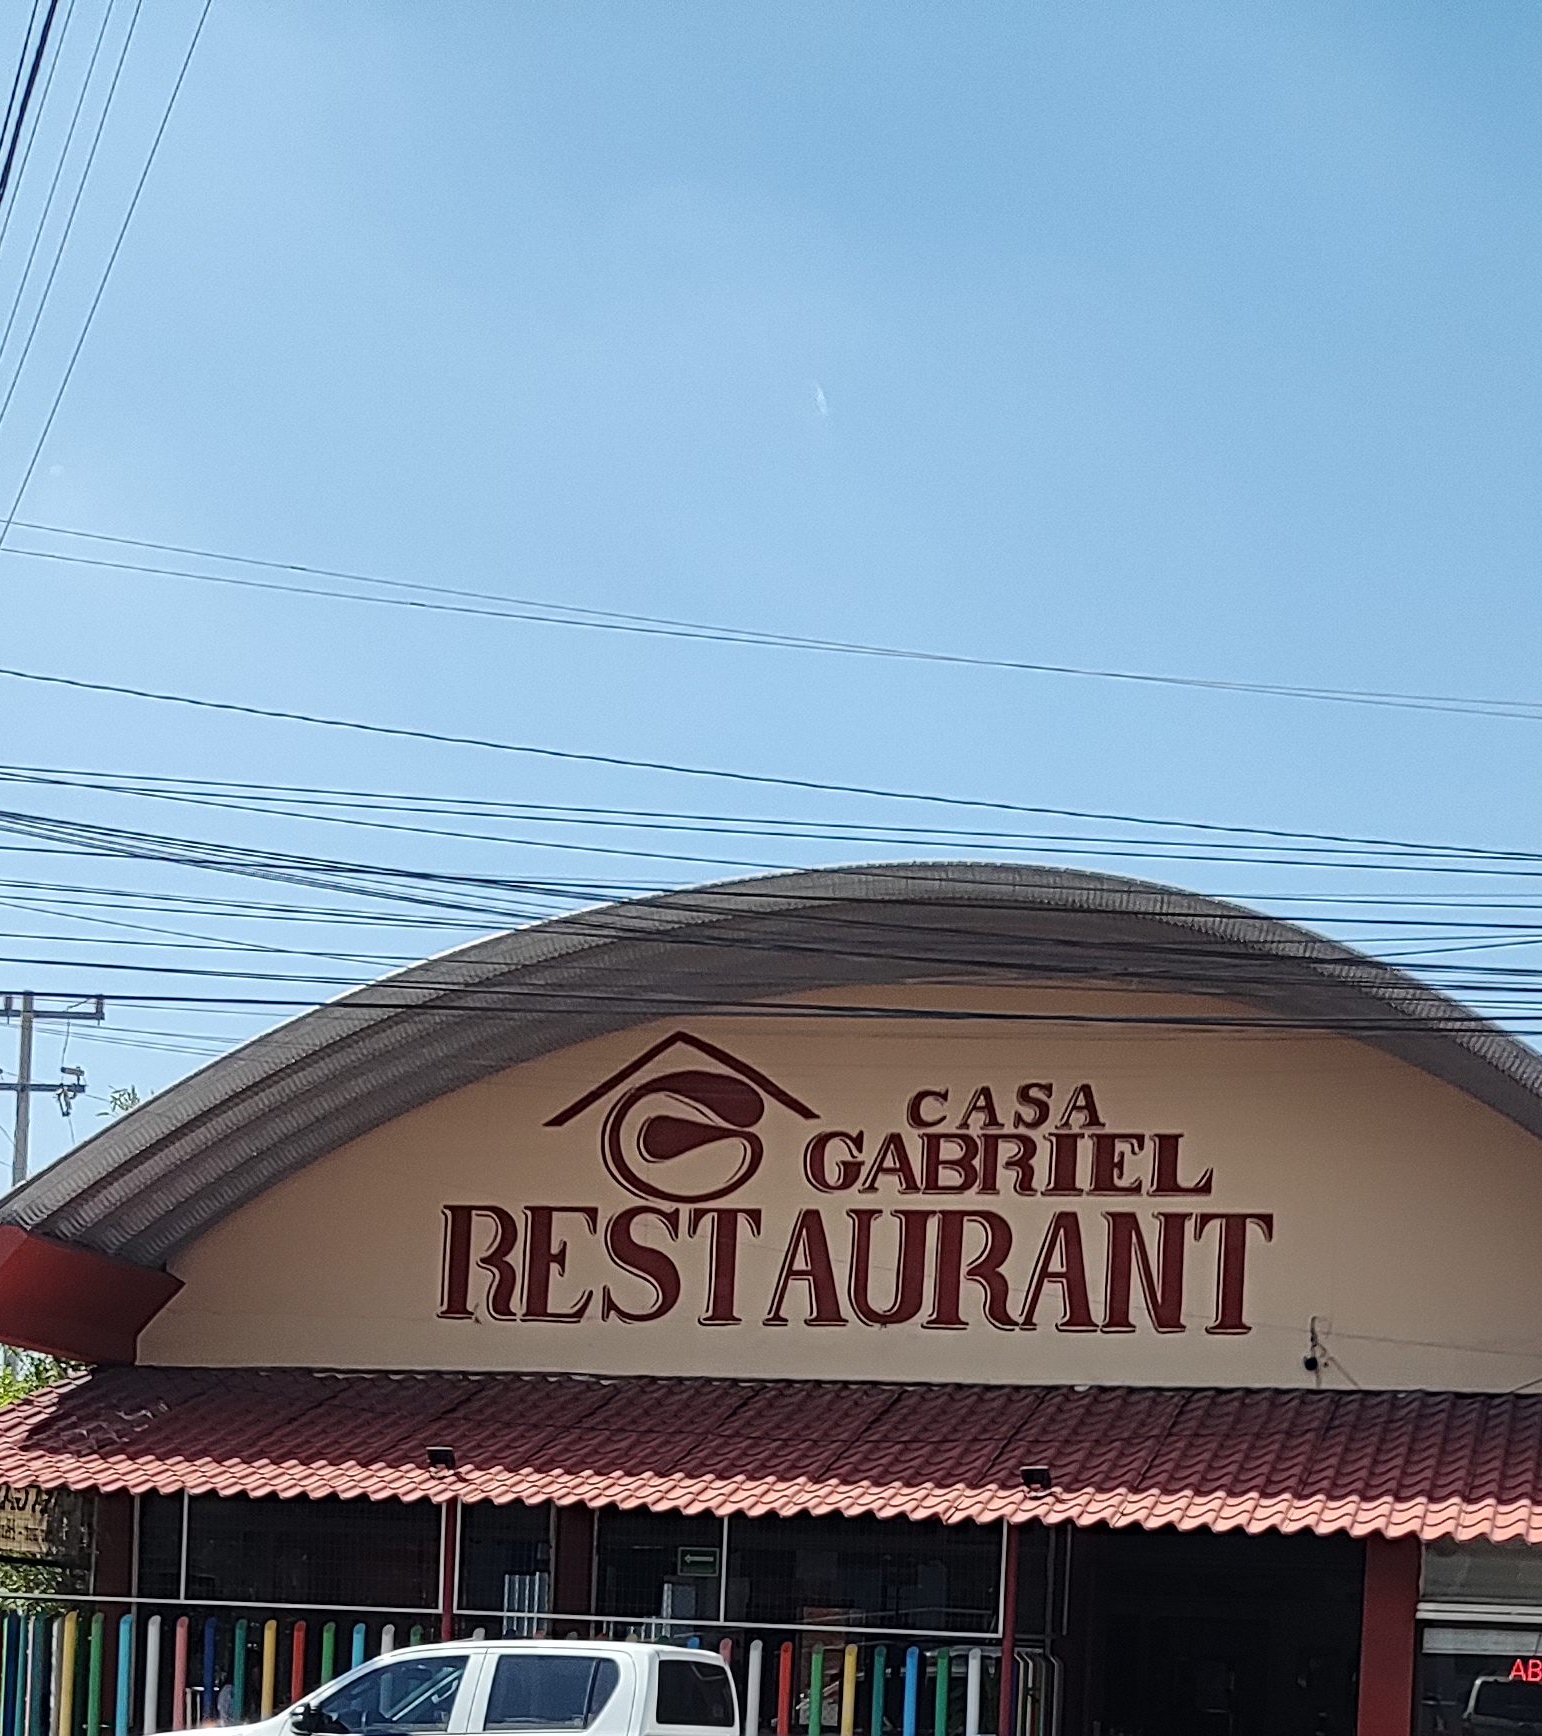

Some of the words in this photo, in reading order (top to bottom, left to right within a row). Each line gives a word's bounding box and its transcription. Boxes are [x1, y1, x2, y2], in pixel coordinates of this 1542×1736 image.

[907, 1082, 1105, 1129] CASA
[803, 1131, 1214, 1197] GABRIEL
[436, 1204, 1274, 1335] RESTAURANT
